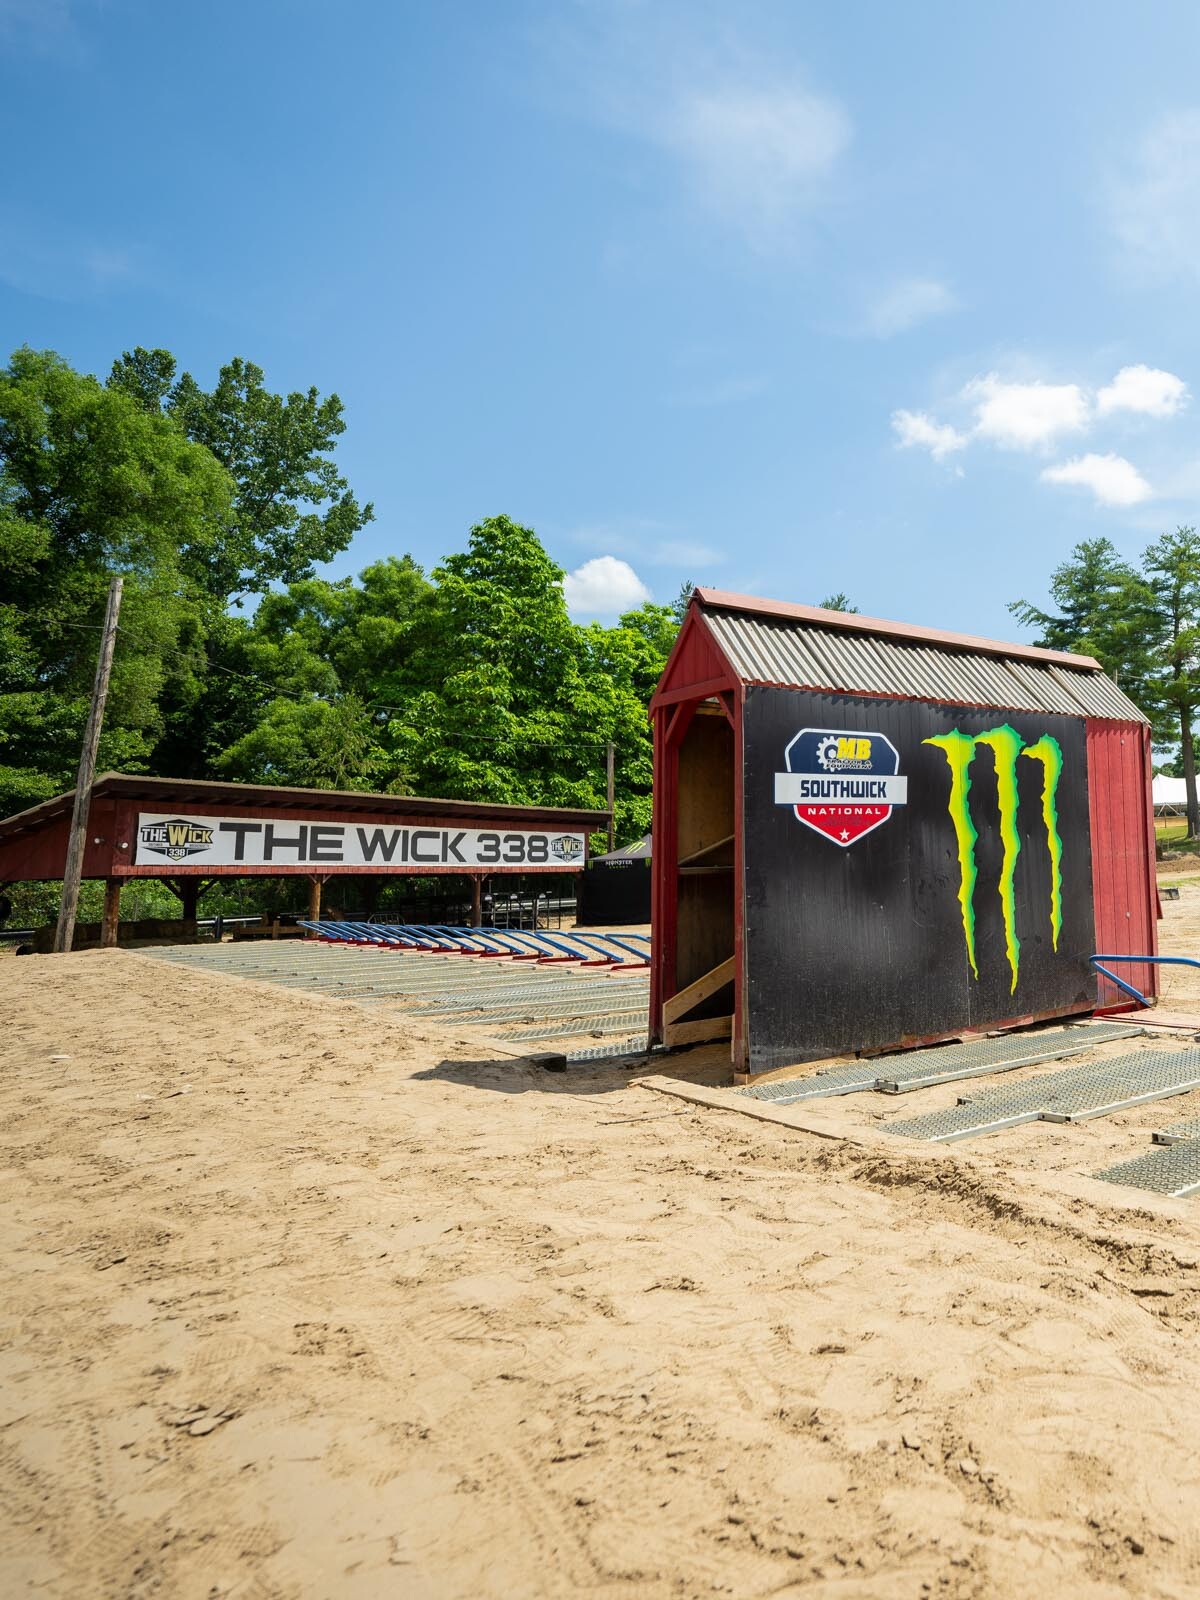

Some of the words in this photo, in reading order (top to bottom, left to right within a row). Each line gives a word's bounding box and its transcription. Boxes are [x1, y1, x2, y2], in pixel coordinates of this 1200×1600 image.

[836, 737, 872, 760] MB
[800, 779, 887, 798] SOUTHWICK
[807, 807, 881, 815] NATIONAL
[141, 828, 167, 842] THE
[219, 821, 345, 861] THE
[356, 827, 468, 862] WICK
[476, 833, 549, 863] 338
[168, 848, 186, 857] 338
[551, 842, 563, 850] THE
